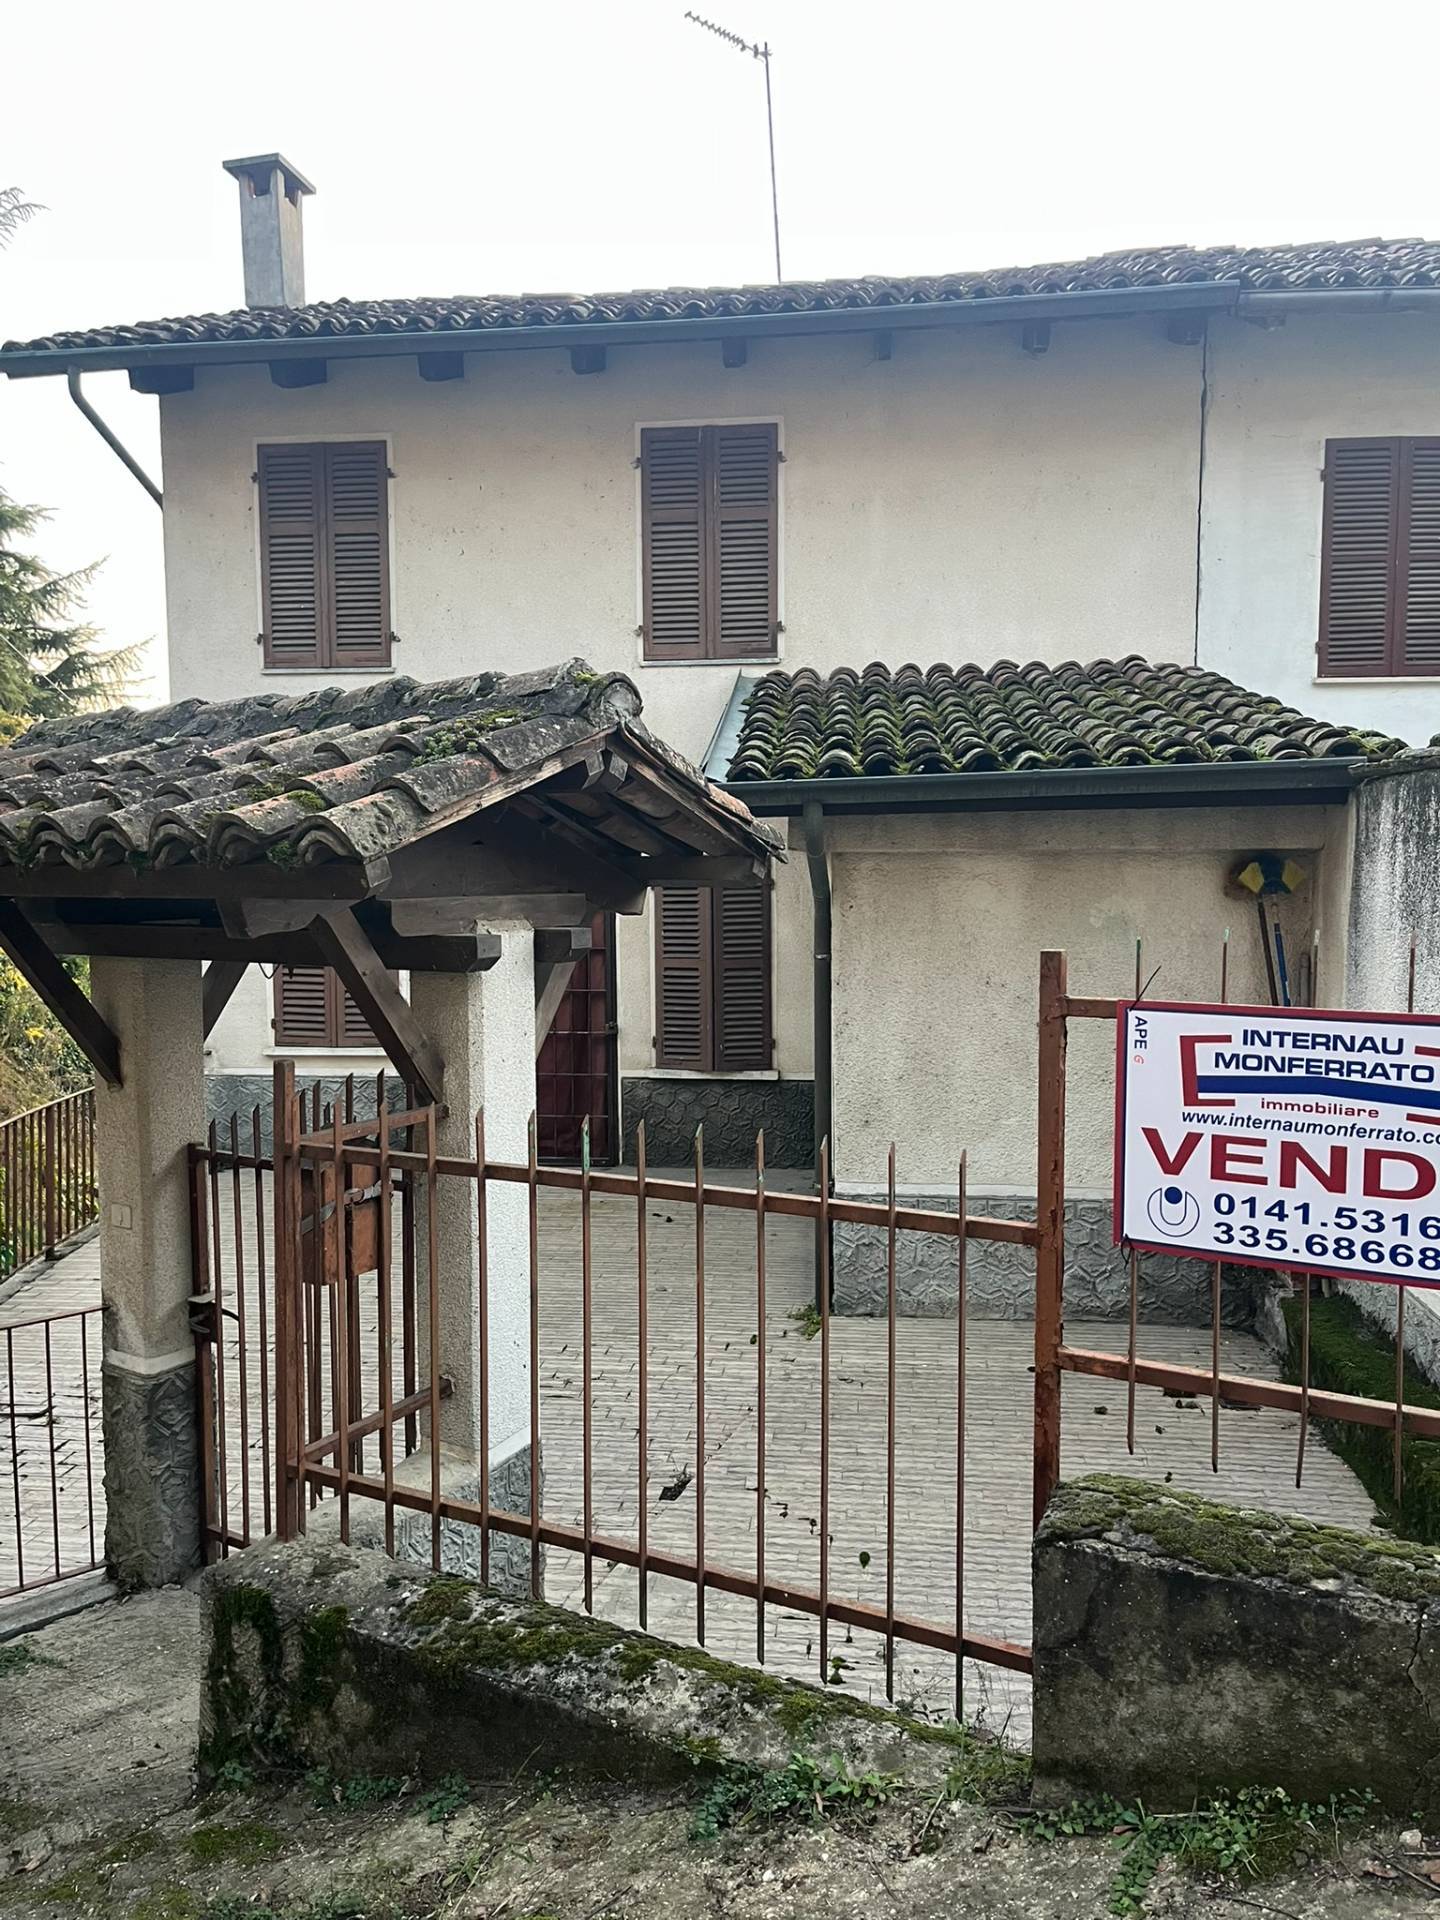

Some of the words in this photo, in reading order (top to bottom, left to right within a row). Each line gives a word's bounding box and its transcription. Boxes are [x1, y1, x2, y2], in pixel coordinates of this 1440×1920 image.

[1134, 1016, 1148, 1049] APE
[1242, 1029, 1404, 1055] INTERNAU
[1133, 1054, 1145, 1065] G
[1214, 1052, 1435, 1083] MONFERRATO
[1261, 1097, 1380, 1118] immobiliare
[1141, 1127, 1437, 1200] VEND
[1213, 1193, 1440, 1240] 0141.5316
[1213, 1222, 1440, 1271] 335.68668
